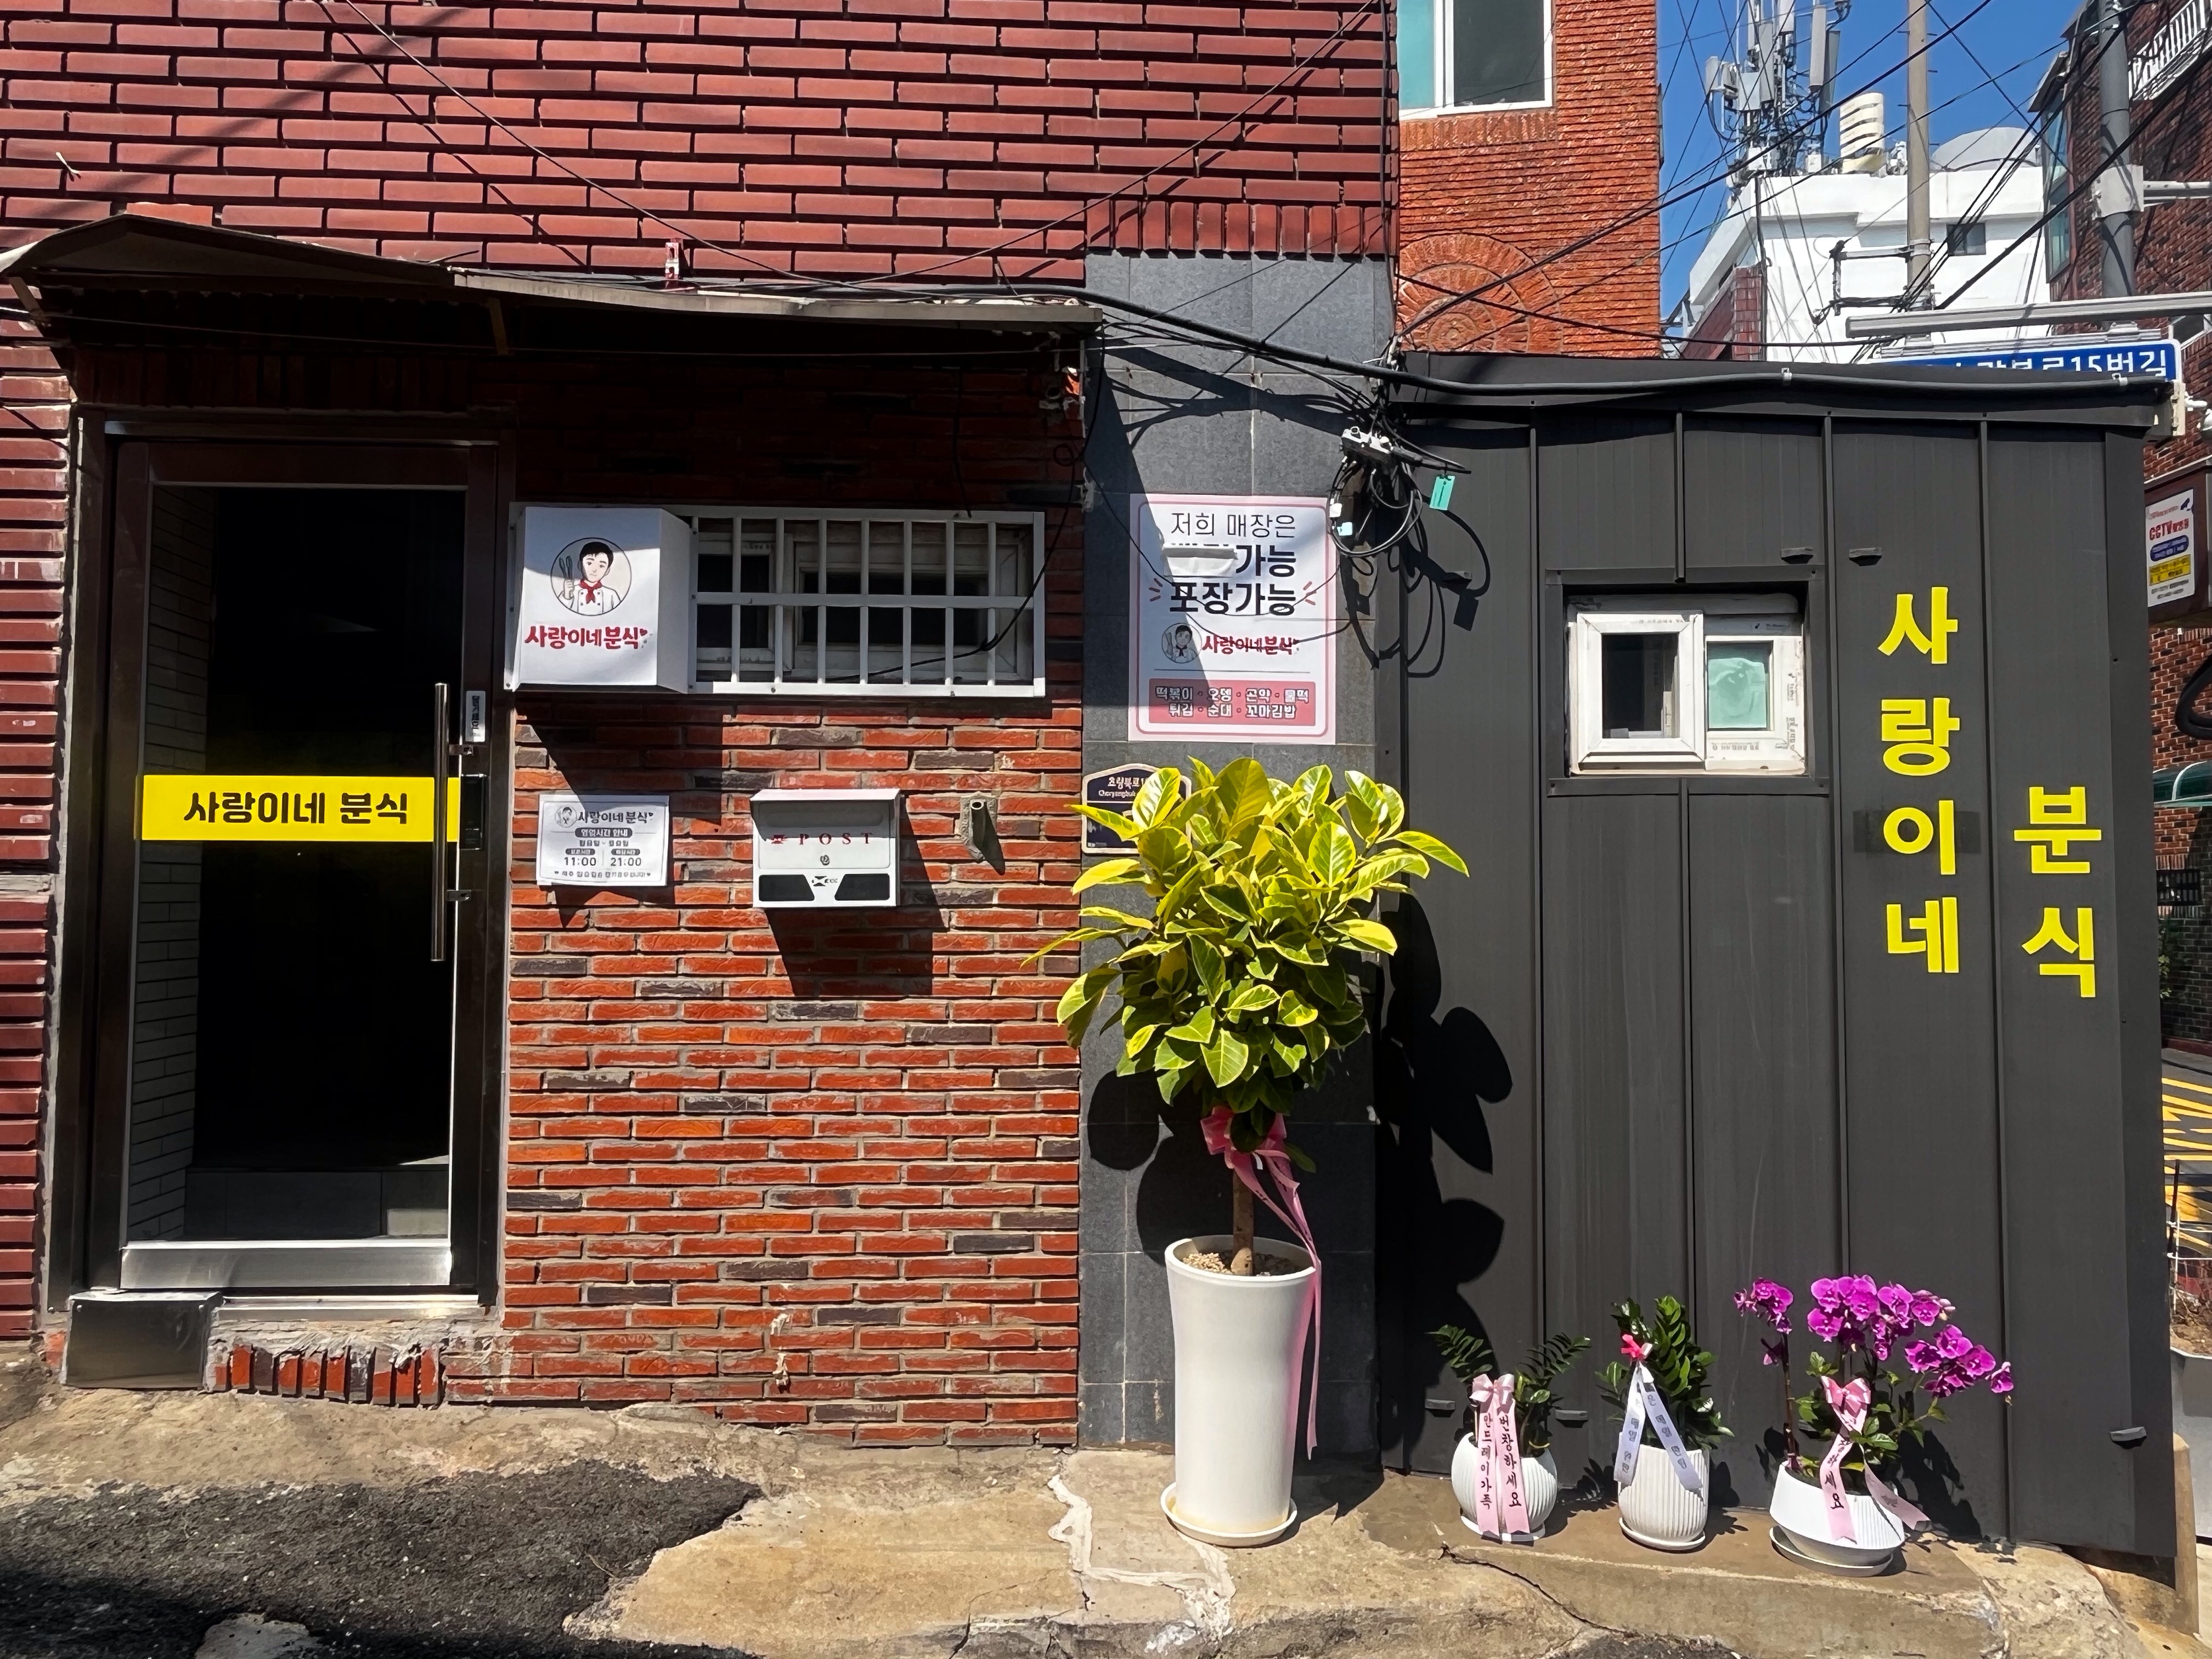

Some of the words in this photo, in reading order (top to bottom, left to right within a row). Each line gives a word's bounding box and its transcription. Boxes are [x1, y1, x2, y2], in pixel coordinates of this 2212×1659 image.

[1171, 512, 1215, 536] 저희
[1227, 514, 1296, 538] 매장은
[1170, 582, 1296, 616] 포장가능
[1207, 703, 1233, 718] 순대
[1245, 704, 1297, 719] 꼬마김밥
[1877, 586, 1961, 974] 사랑이네
[183, 791, 326, 823] 사랑이네
[340, 793, 408, 825] 분식
[799, 832, 873, 845] POST
[565, 857, 596, 866] 11:00
[611, 857, 641, 866] 21:00
[2013, 786, 2102, 998] 분식
